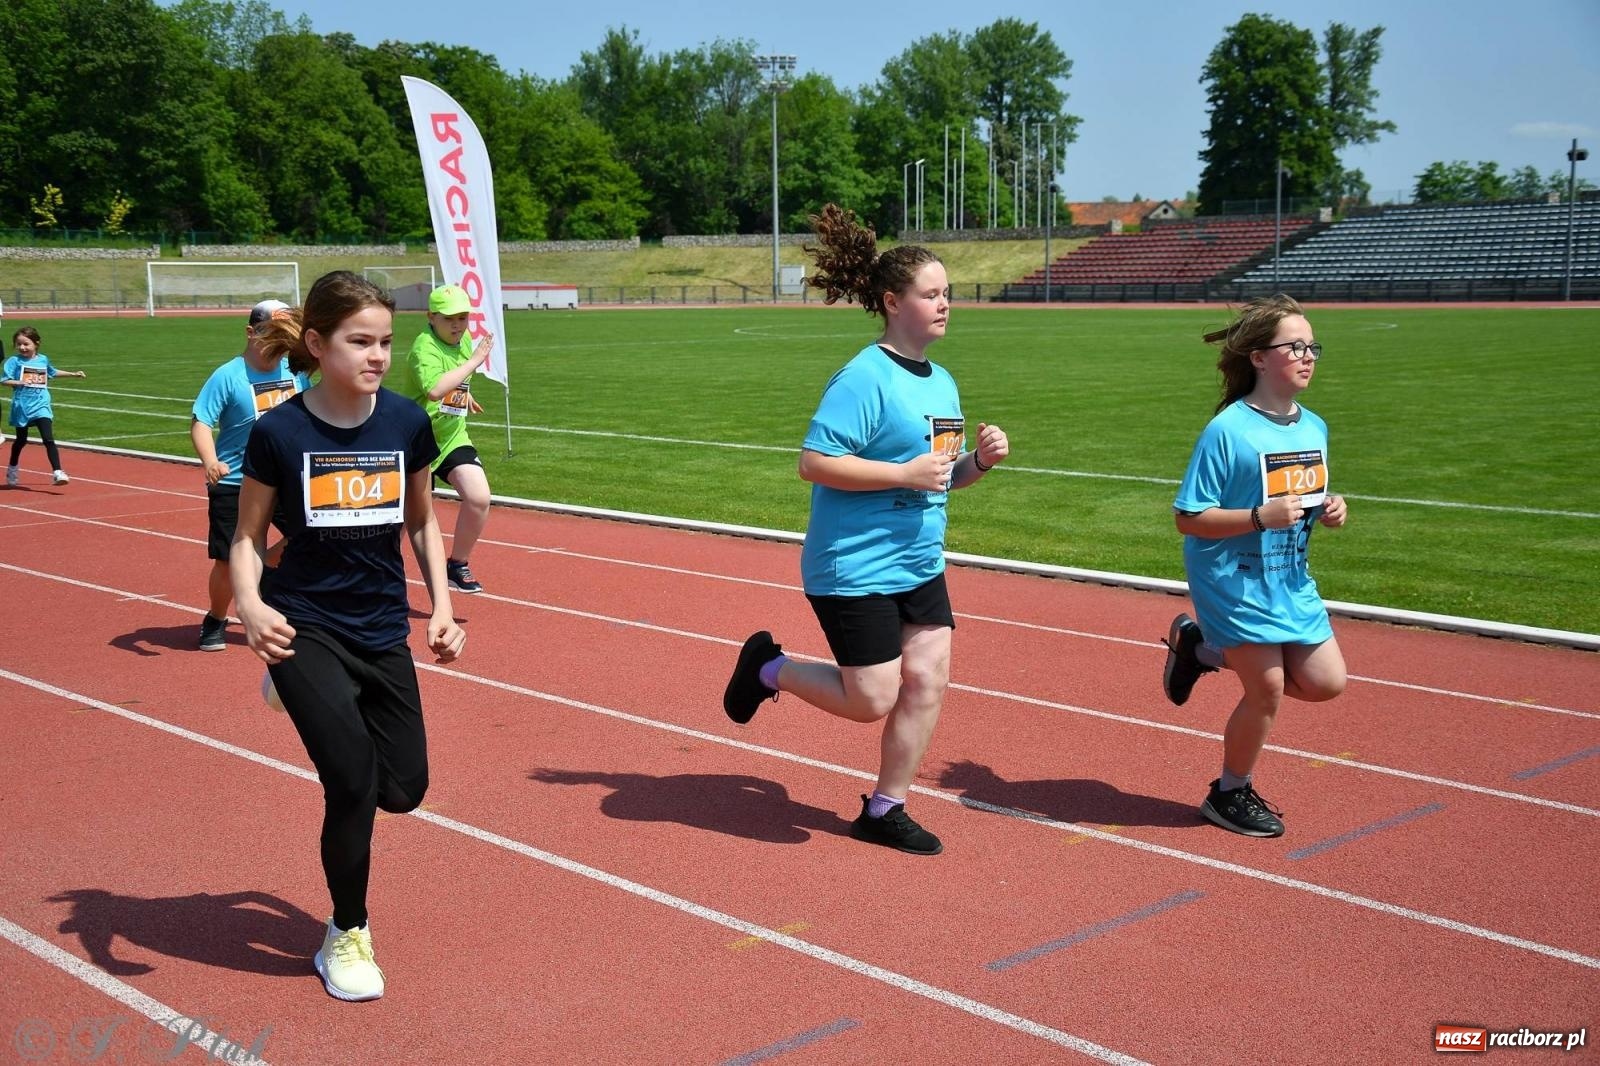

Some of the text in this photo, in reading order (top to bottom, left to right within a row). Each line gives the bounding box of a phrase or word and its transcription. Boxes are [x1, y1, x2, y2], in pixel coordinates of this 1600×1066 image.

[943, 436, 960, 456] 122
[334, 475, 383, 502] 104
[1284, 469, 1317, 490] 120
